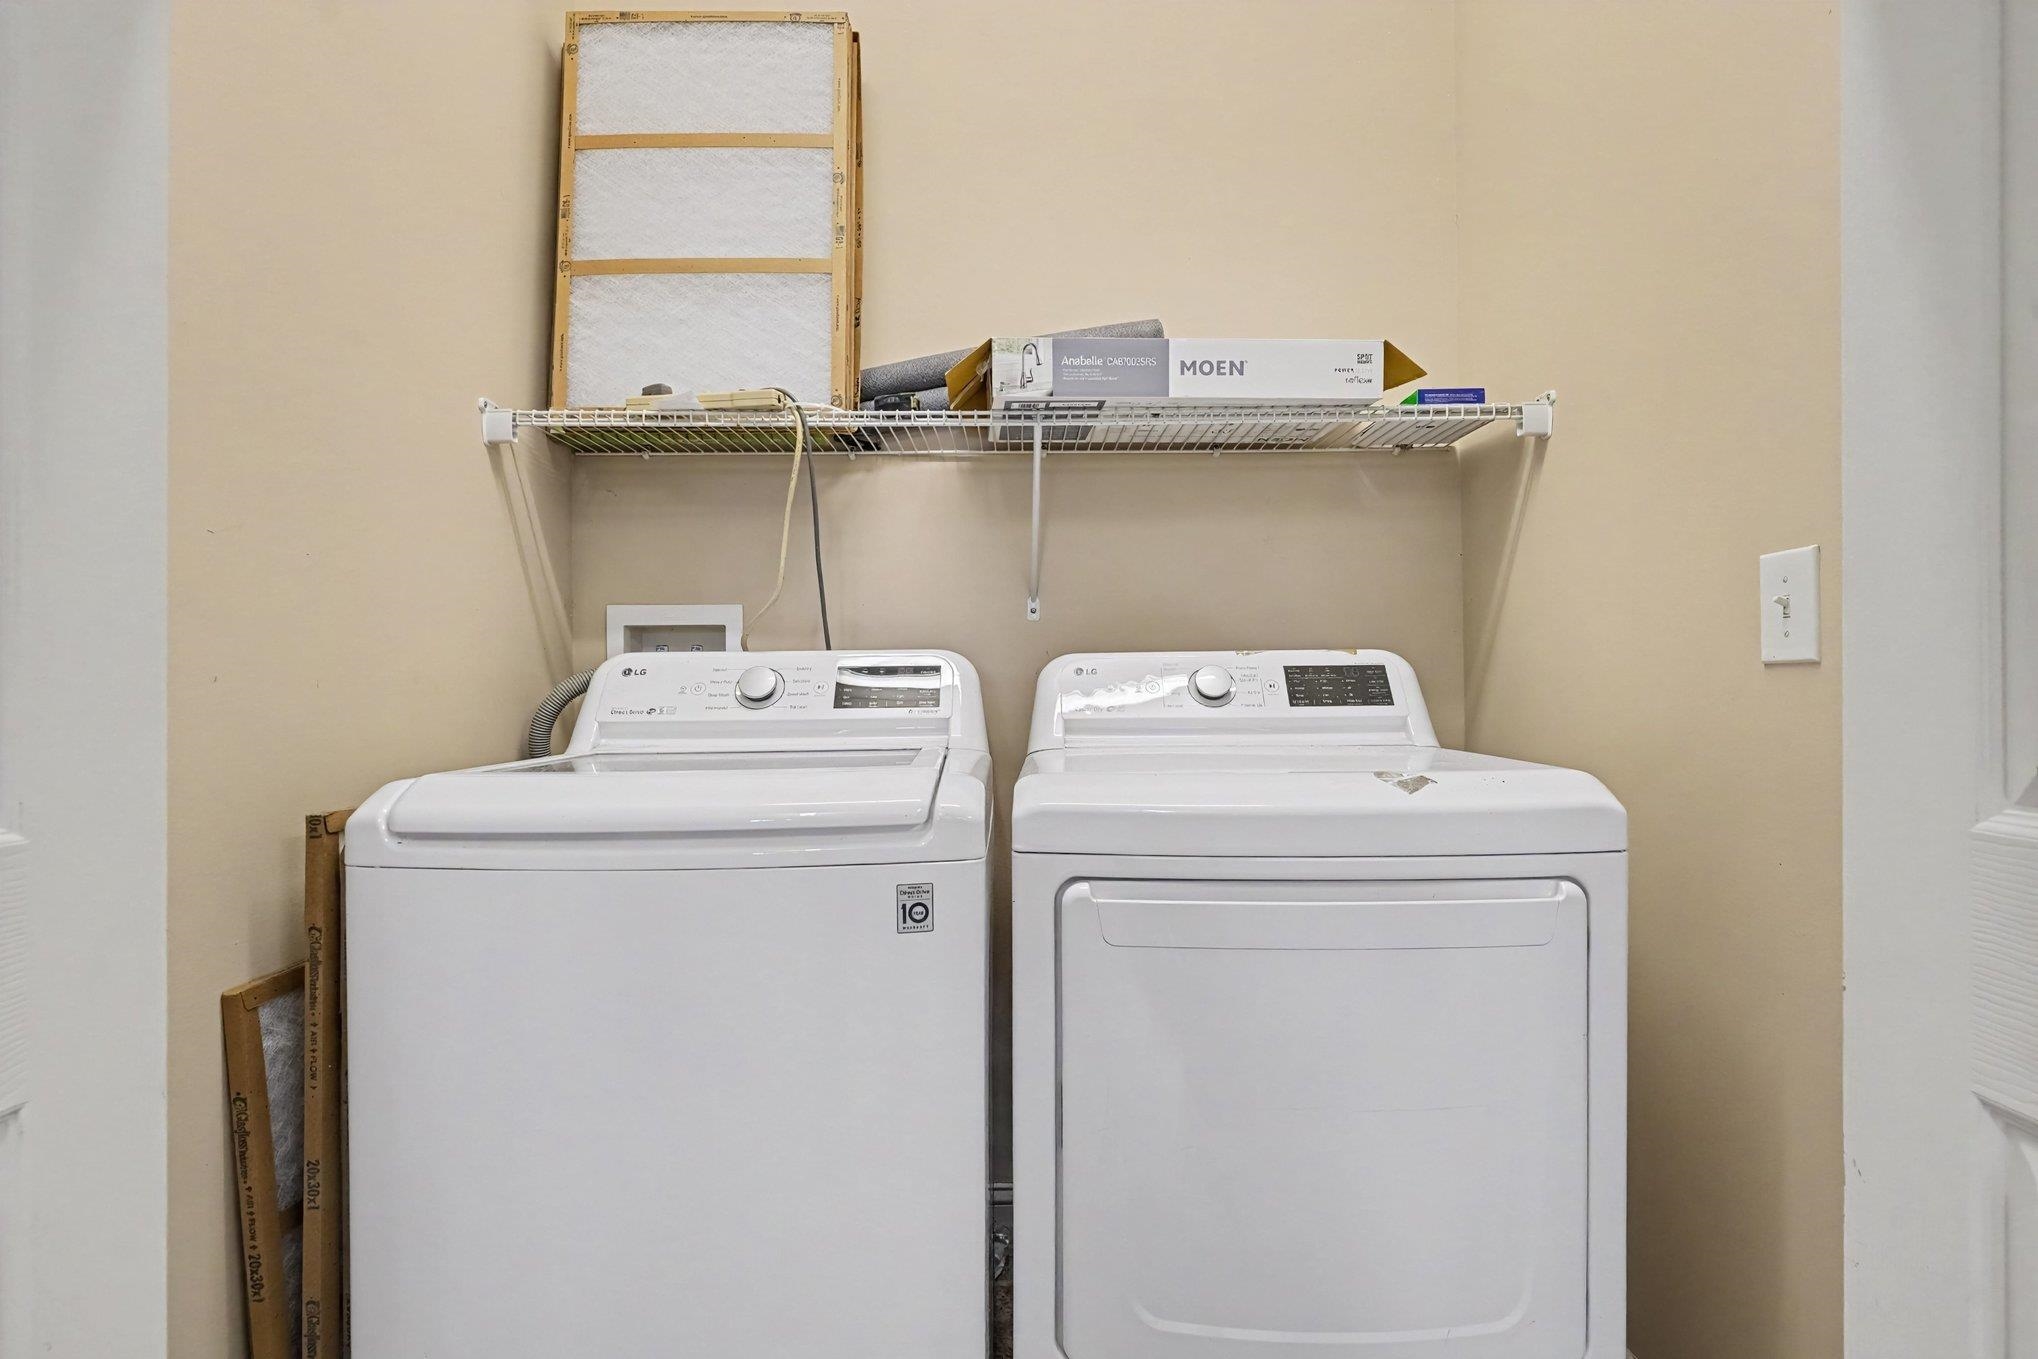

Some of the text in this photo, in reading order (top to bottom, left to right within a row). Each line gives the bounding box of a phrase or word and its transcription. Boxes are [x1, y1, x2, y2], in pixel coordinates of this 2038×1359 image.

[1061, 355, 1103, 366] Anabelle
[1179, 359, 1245, 376] MOEN
[634, 668, 647, 676] LG
[1085, 668, 1098, 676] LG
[306, 1159, 320, 1210] 20x30x1
[248, 1254, 265, 1303] 20x30x1
